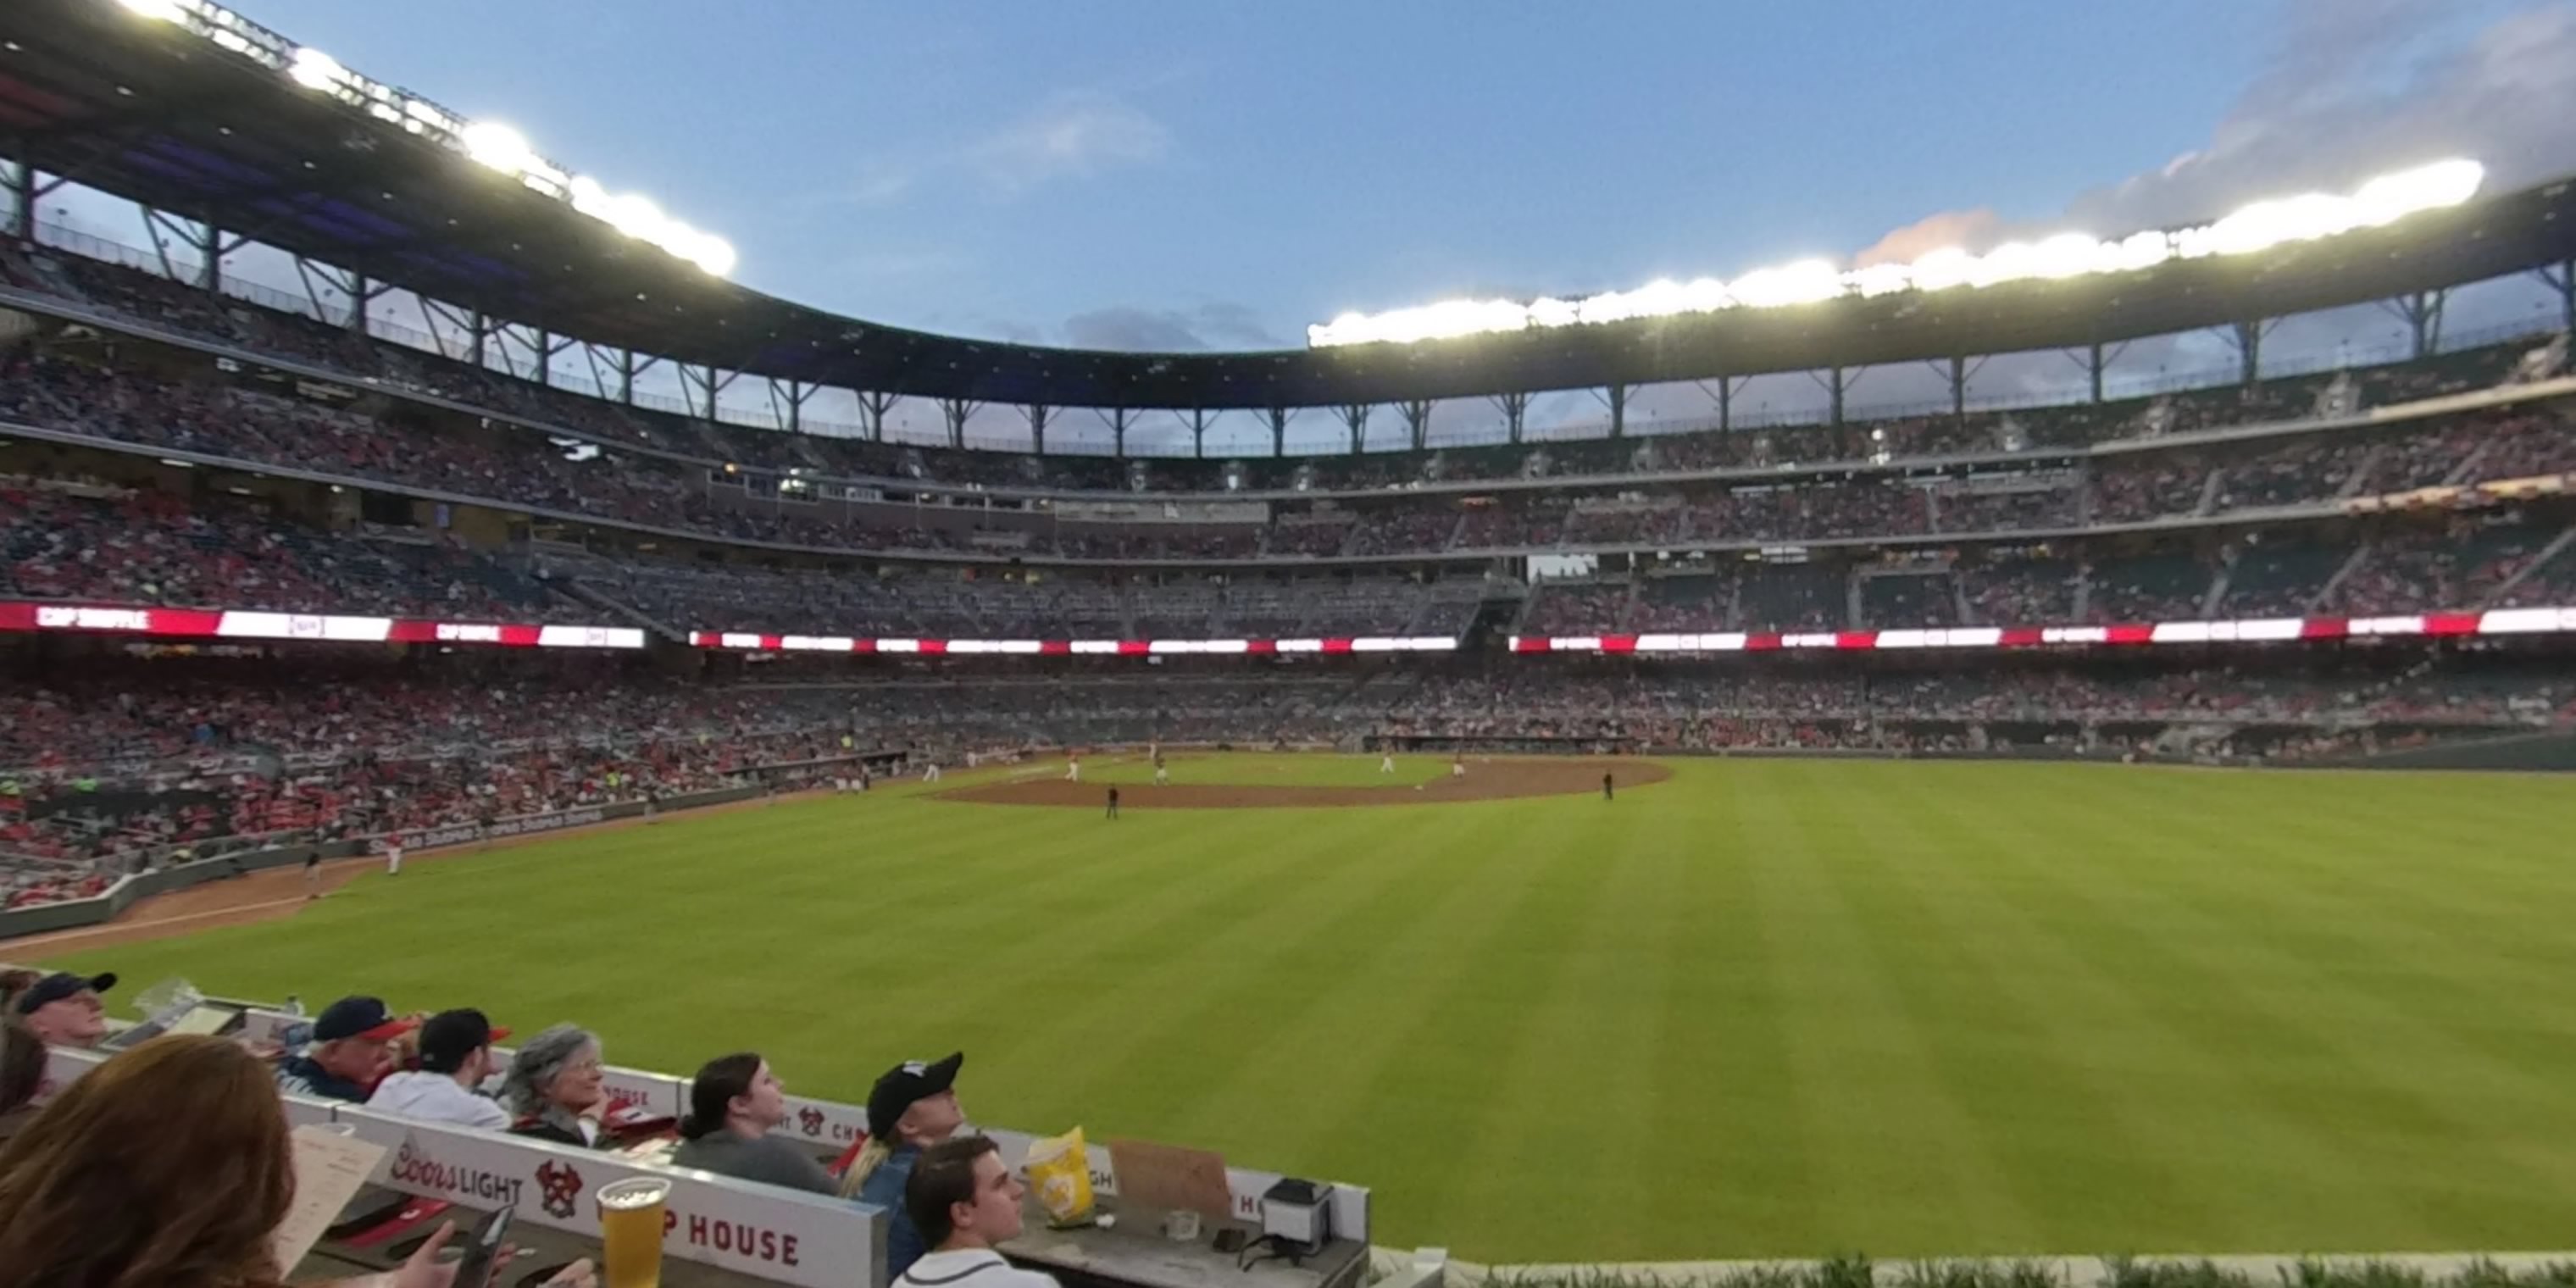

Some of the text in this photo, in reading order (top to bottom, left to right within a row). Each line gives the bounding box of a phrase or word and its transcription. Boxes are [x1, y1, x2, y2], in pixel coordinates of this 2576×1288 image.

[391, 1141, 458, 1191] Coors
[460, 1167, 524, 1206] LIGHT
[689, 1213, 799, 1267] HOUSE
